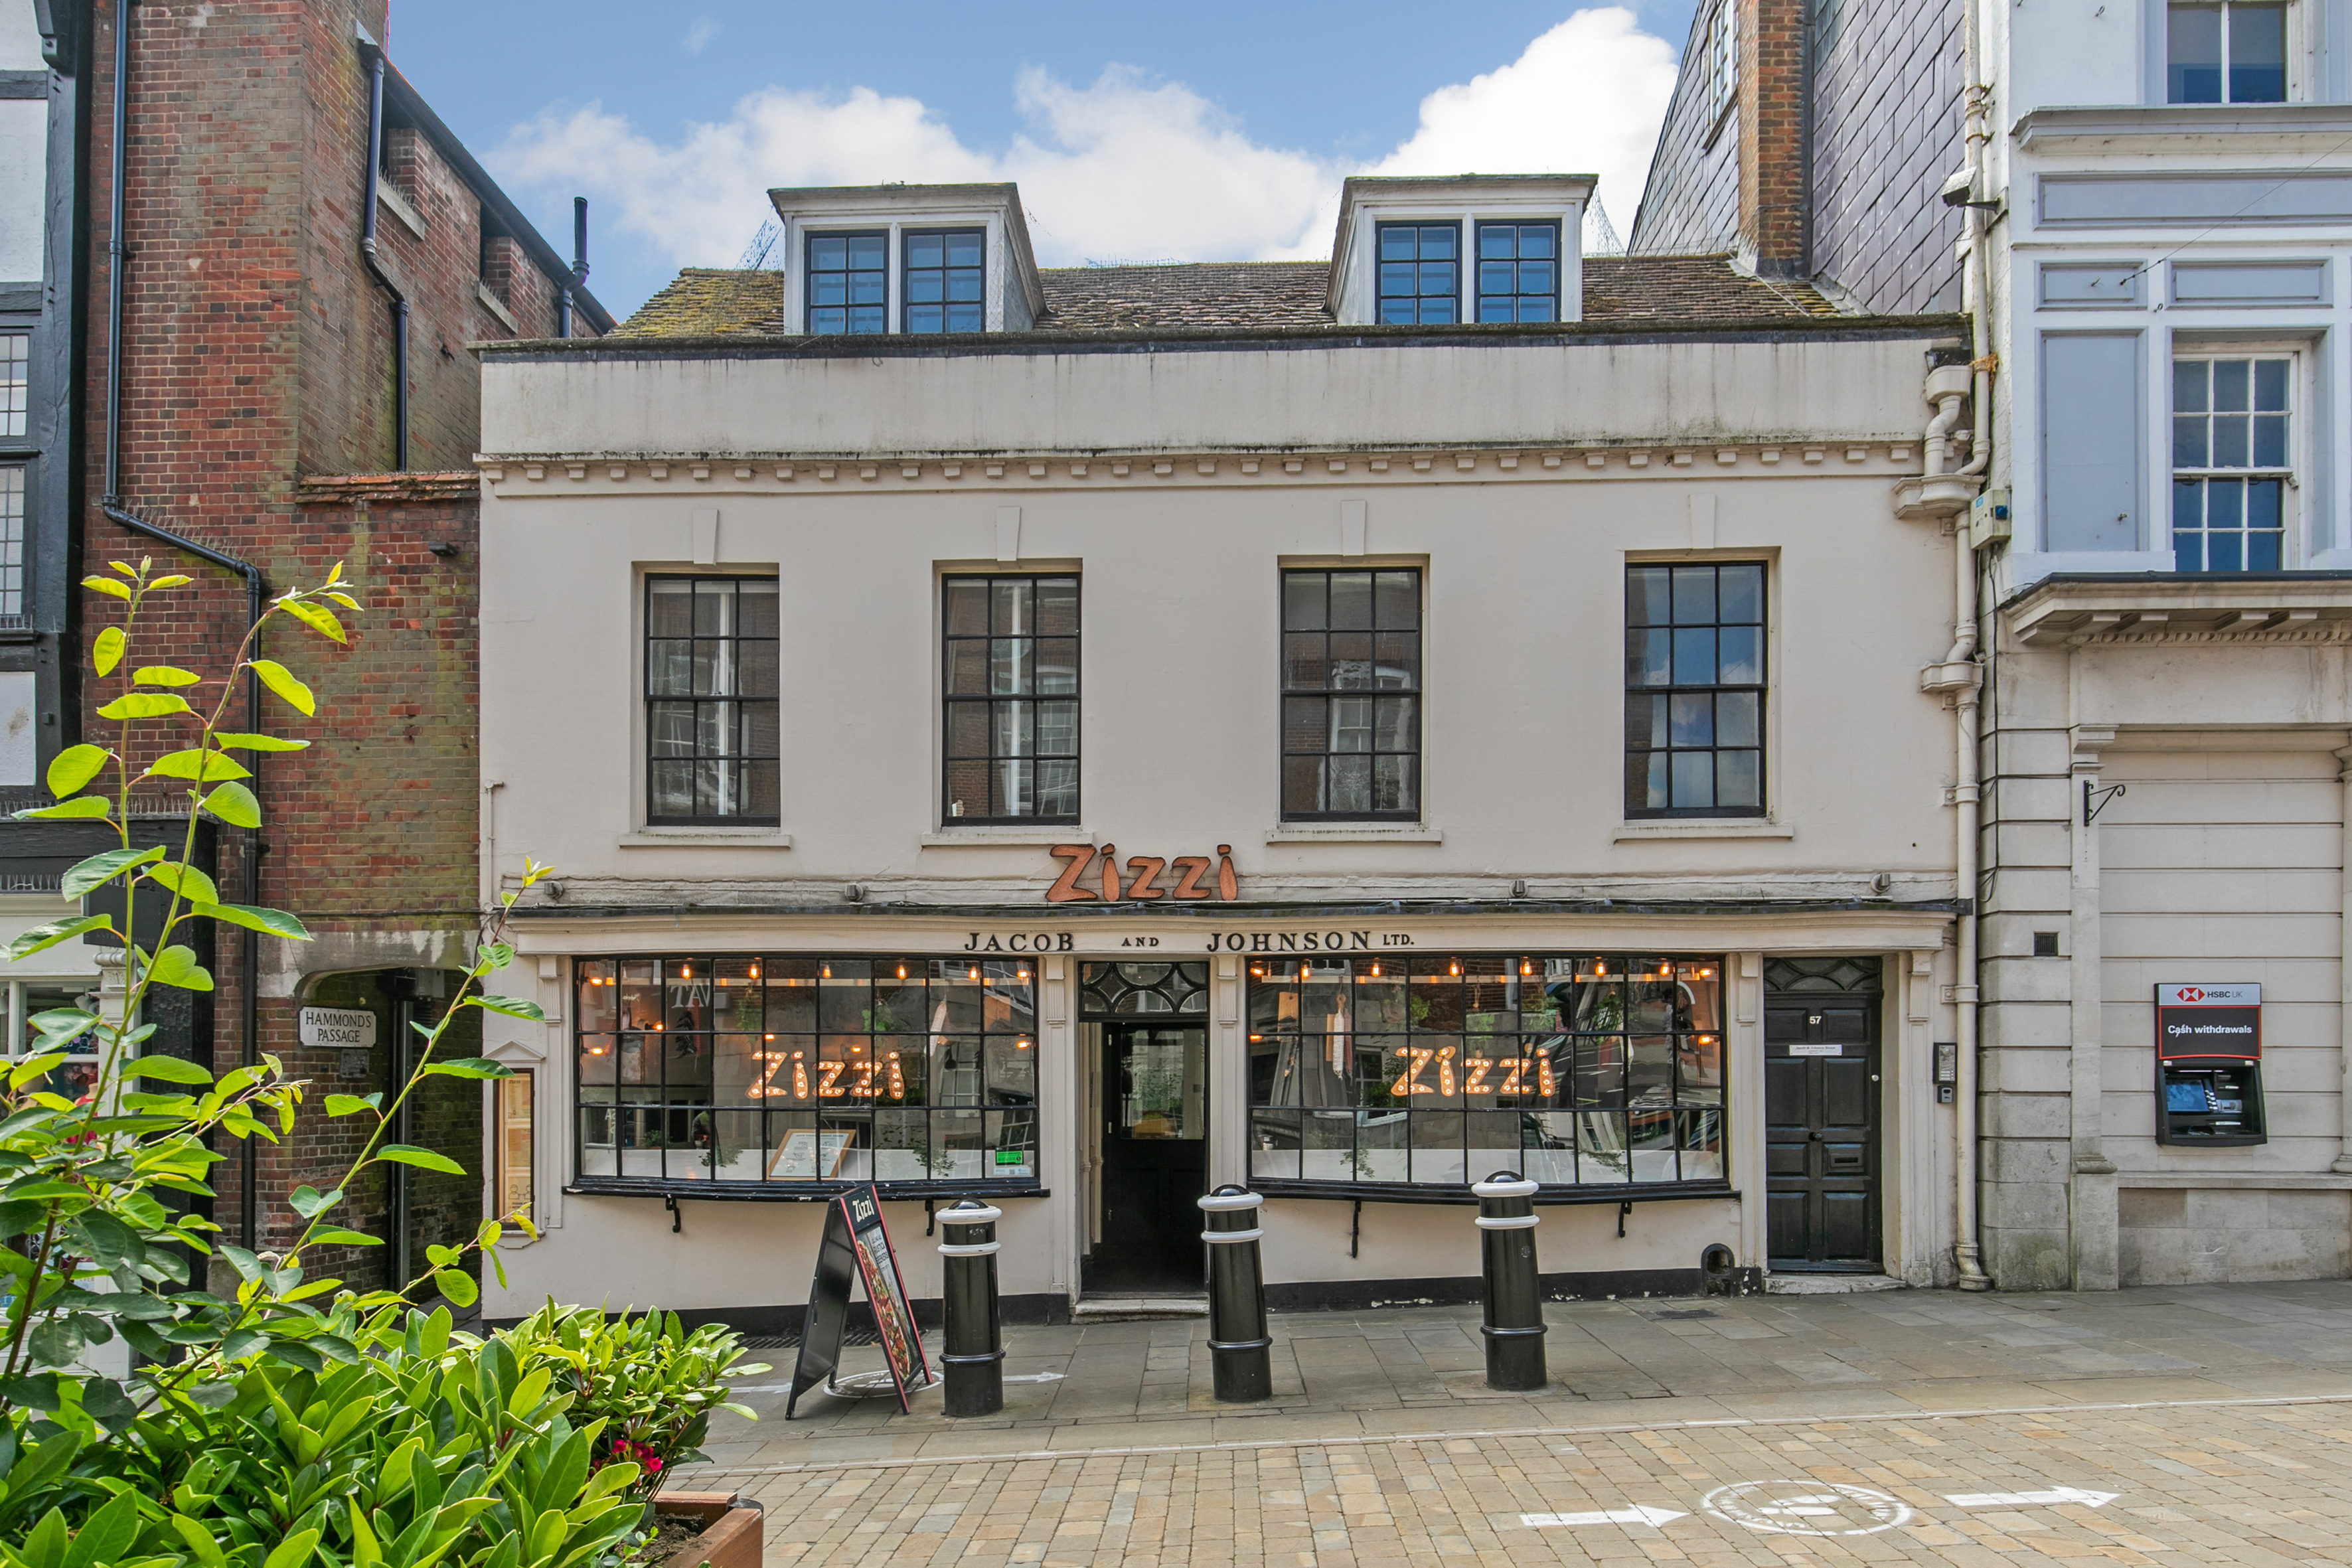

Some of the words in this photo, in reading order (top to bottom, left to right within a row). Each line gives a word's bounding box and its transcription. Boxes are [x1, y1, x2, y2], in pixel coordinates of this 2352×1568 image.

[1046, 843, 1239, 902] Zizzi
[965, 932, 1074, 952] JACOB
[1121, 937, 1160, 948] AND
[1207, 931, 1371, 952] JOHNSON
[1383, 933, 1415, 946] LTD.
[306, 1011, 371, 1028] HAMMOND'S
[1809, 1015, 1822, 1024] 57
[2167, 1024, 2192, 1036] Cash
[2194, 1024, 2252, 1034] withdrawals
[317, 1028, 360, 1042] PASSAGE
[745, 1050, 905, 1099] Zizzi
[1391, 1046, 1555, 1097] Zizzi
[852, 1195, 874, 1222] Zizzi
